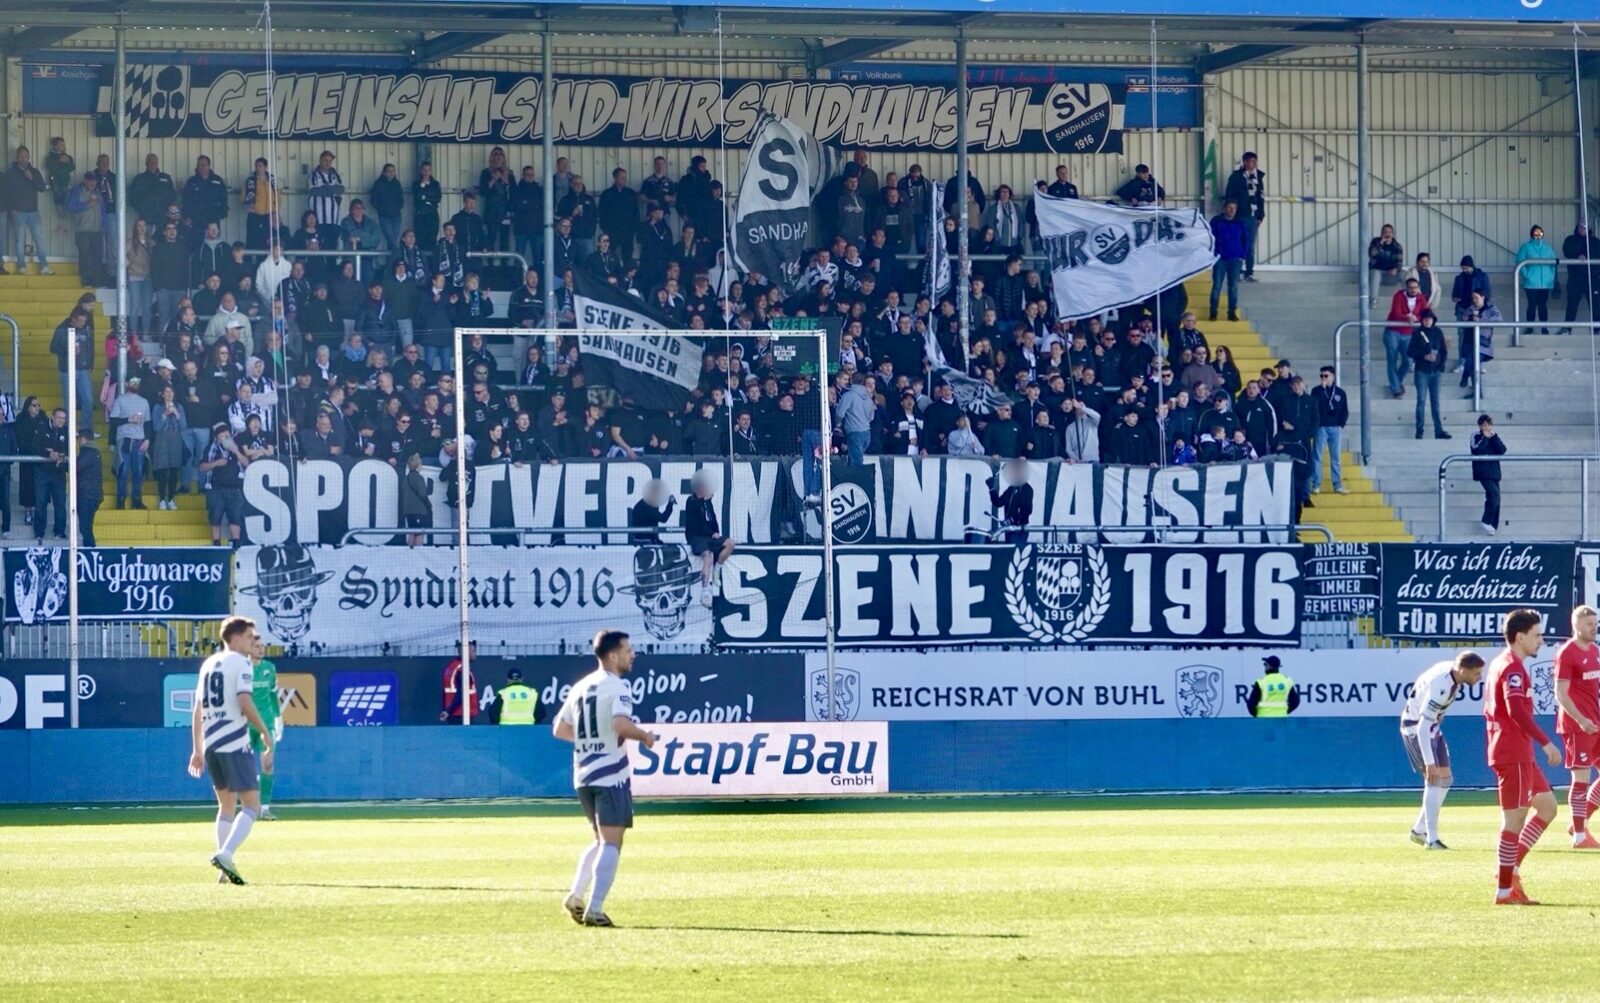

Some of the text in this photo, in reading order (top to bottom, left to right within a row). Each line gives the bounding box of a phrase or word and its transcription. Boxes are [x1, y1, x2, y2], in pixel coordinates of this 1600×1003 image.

[865, 71, 903, 80] Volksbank
[201, 69, 1033, 151] GEMEINSAM SIND WIR SANDHAUSEN
[1052, 83, 1091, 120] SV
[1055, 110, 1106, 142] SANDHAUSEN
[1074, 134, 1095, 151] 1916
[1094, 226, 1117, 249] SV
[831, 488, 855, 516] SV
[833, 508, 867, 531] SANDHAUSEN
[847, 524, 861, 536] 1916
[1036, 543, 1083, 554] SZENE
[1314, 543, 1369, 557] NIEMALS
[1413, 546, 1544, 573] Was ich liebe,
[77, 551, 224, 593] Nightmares
[1315, 560, 1367, 576] ALLEINE
[122, 585, 174, 612] 1916
[338, 565, 616, 618] Syndikat 1916
[720, 551, 1300, 638] SZENE 1916
[1321, 579, 1361, 595] IMMER
[1397, 575, 1433, 599] das
[1436, 574, 1524, 600] beschütze
[1530, 575, 1558, 600] ich
[1044, 609, 1074, 621] 1916
[1304, 598, 1375, 614] GEMEINSAM
[1398, 608, 1438, 634] FÜR
[541, 675, 572, 705] de
[622, 669, 686, 704] gion
[872, 685, 1165, 708] REICHSRAT VON BUHL
[1235, 683, 1377, 704] RHSRAT
[578, 695, 599, 739] 11
[633, 732, 878, 784] Stapf-Bau
[830, 775, 874, 786] GmbH
